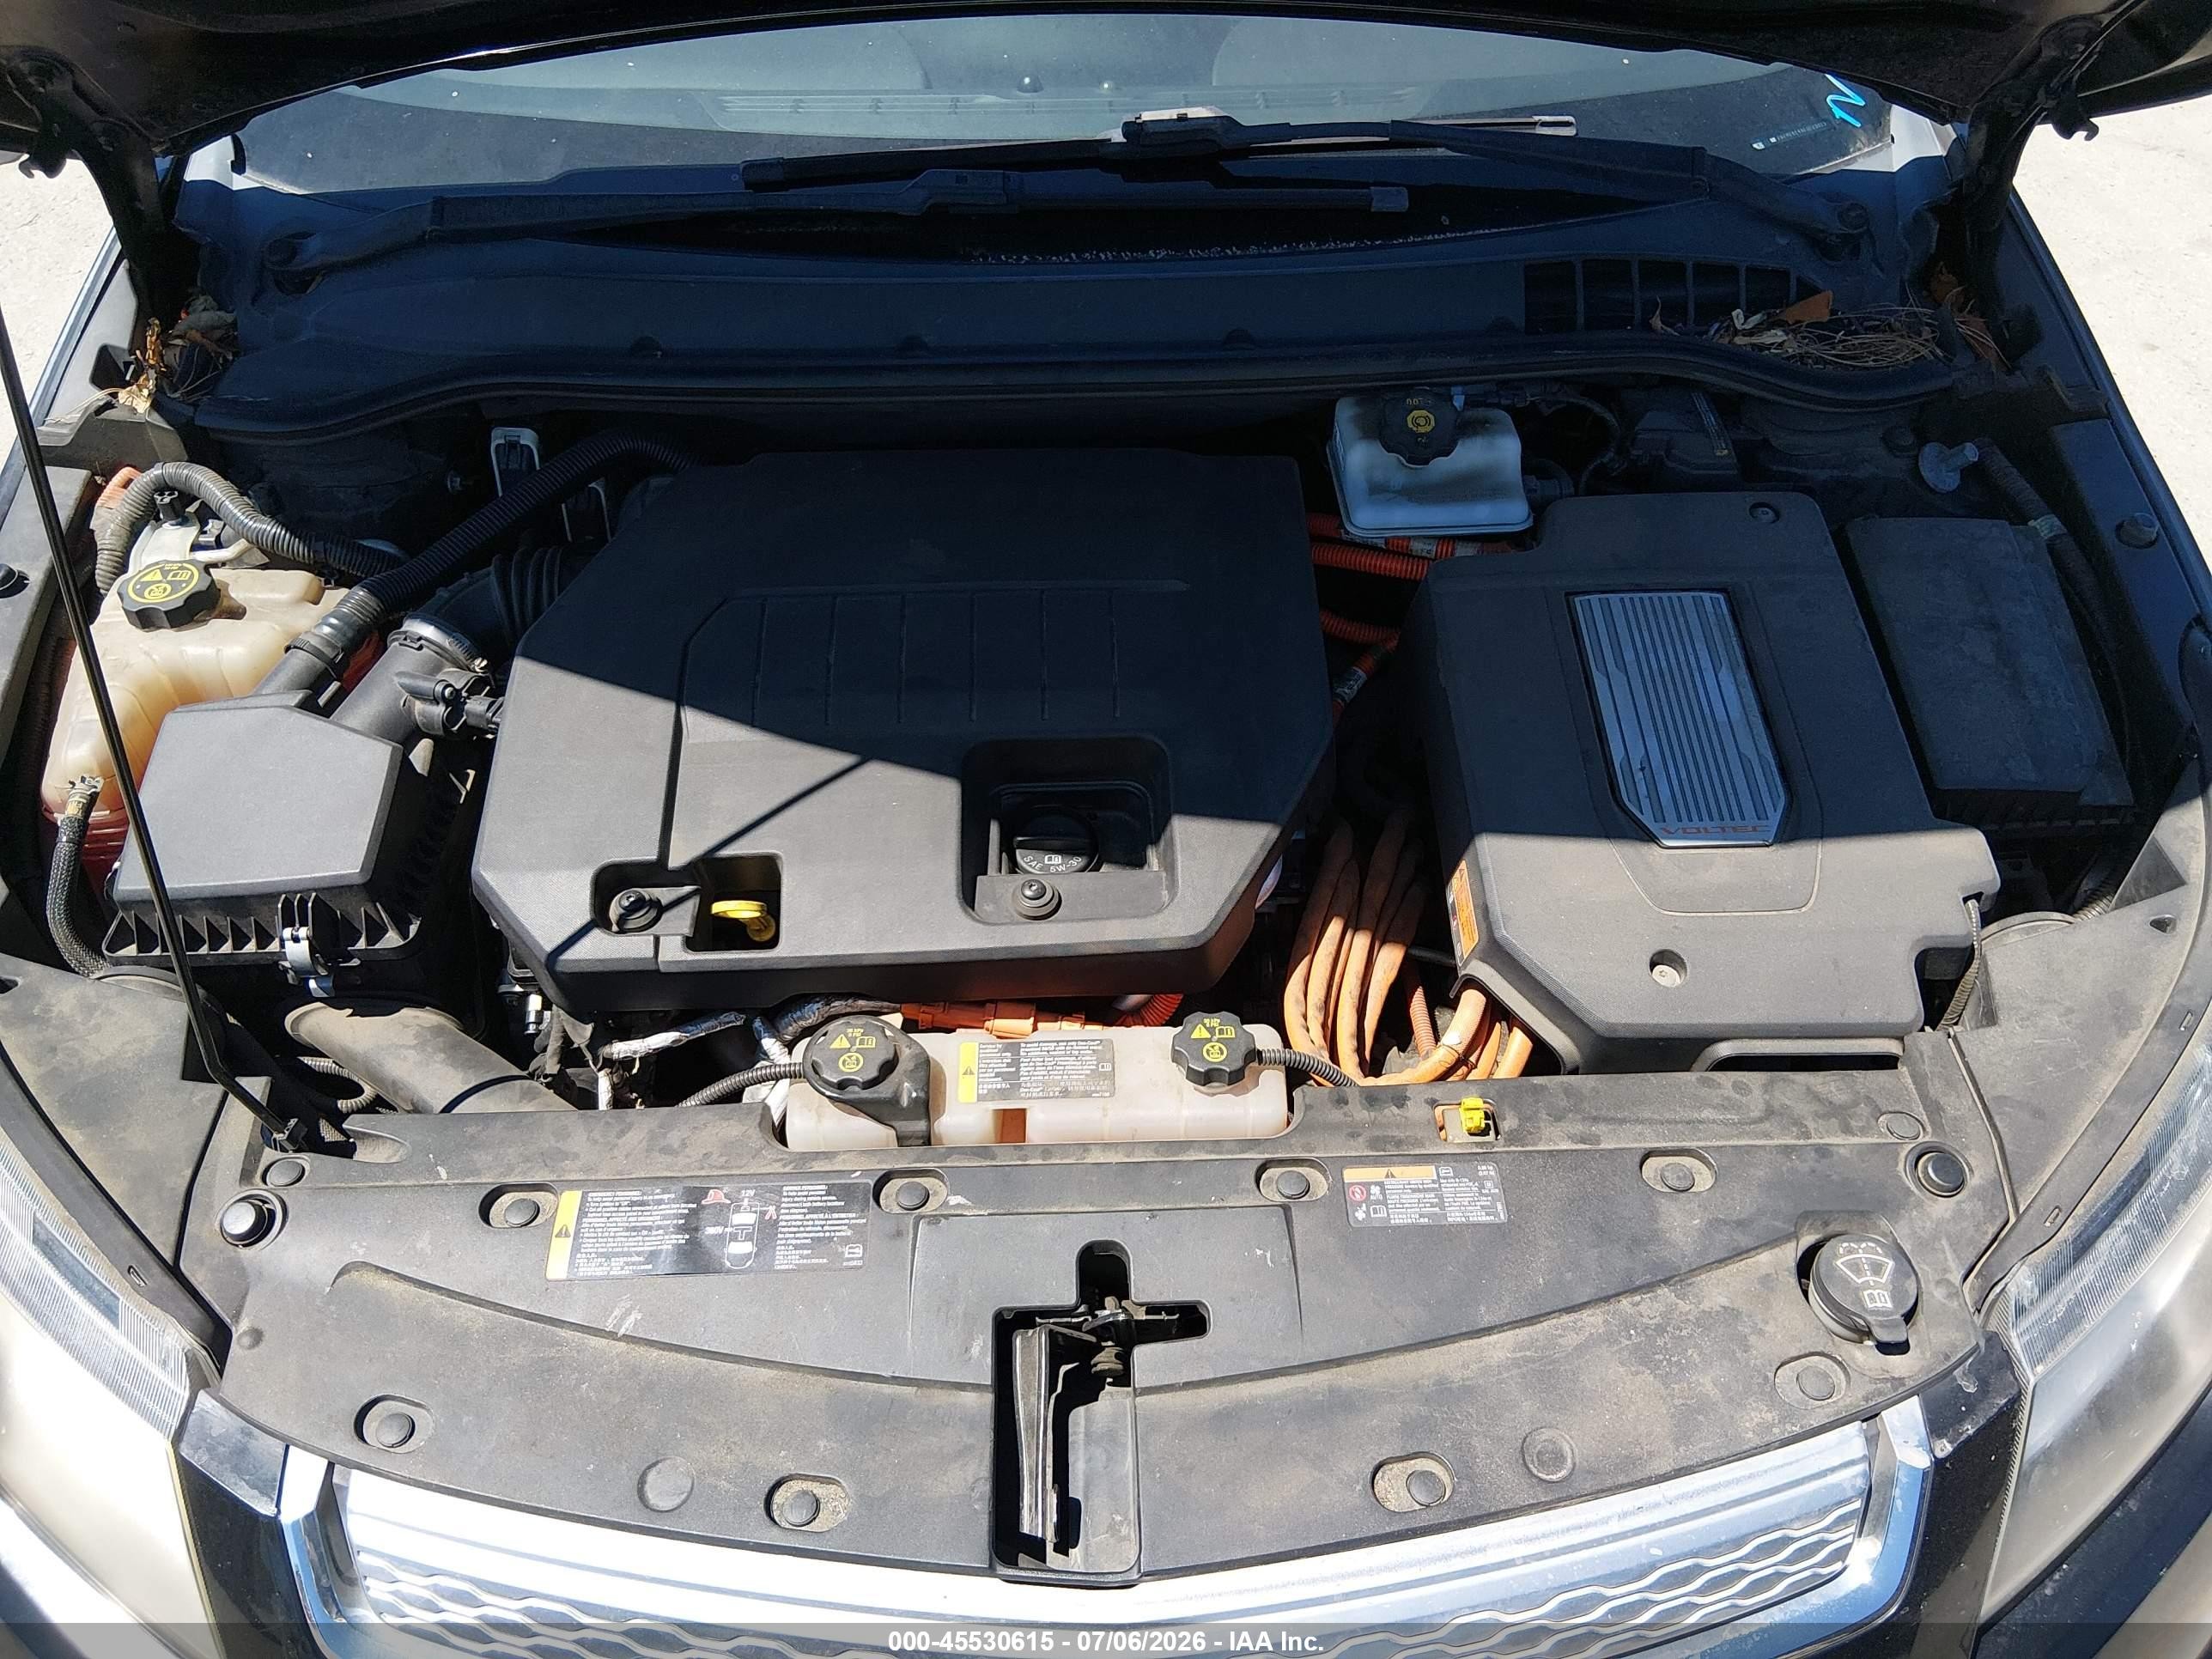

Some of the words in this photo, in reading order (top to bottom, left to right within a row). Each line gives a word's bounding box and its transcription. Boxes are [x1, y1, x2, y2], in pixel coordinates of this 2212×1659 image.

[1660, 825, 1771, 836] VOLTEC
[1024, 855, 1043, 871] SAE
[1049, 856, 1082, 872] 5W-30
